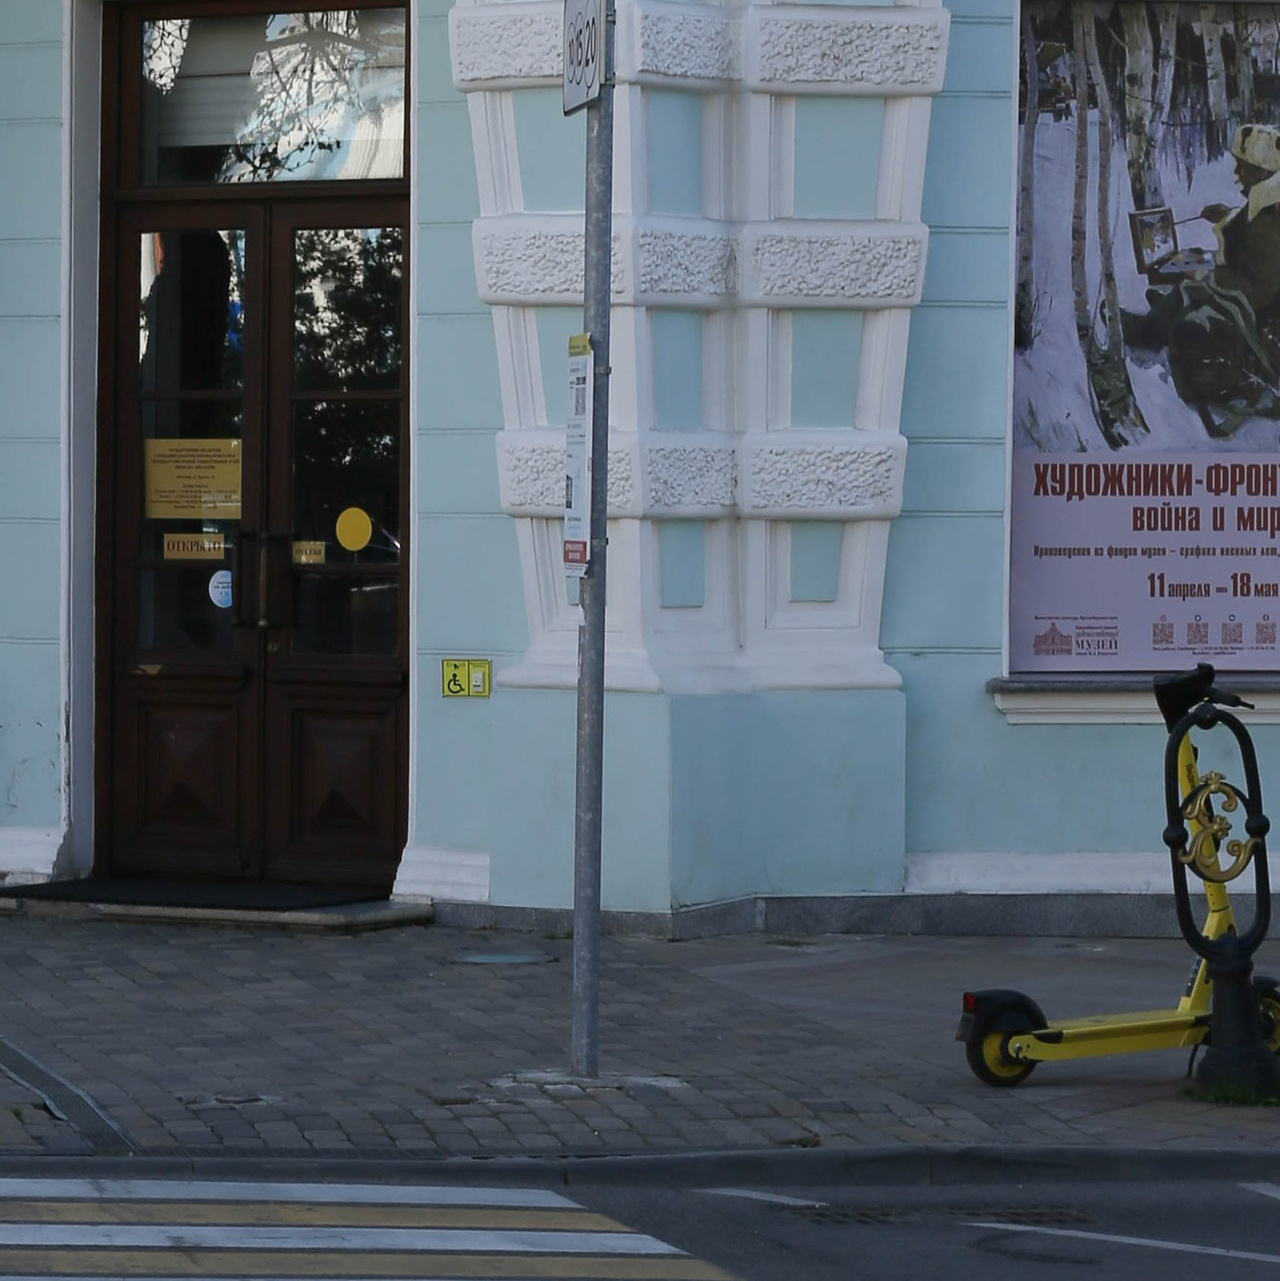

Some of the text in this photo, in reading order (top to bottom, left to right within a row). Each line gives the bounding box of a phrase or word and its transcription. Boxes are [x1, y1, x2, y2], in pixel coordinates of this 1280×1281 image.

[585, 16, 597, 68] 20
[1033, 463, 1280, 502] ХУДОЖНИКИ-ФРОН
[1212, 506, 1225, 531] и
[1147, 572, 1166, 598] 11
[1168, 583, 1211, 601] апреля
[1230, 572, 1251, 598] 18
[1254, 583, 1278, 598] мая
